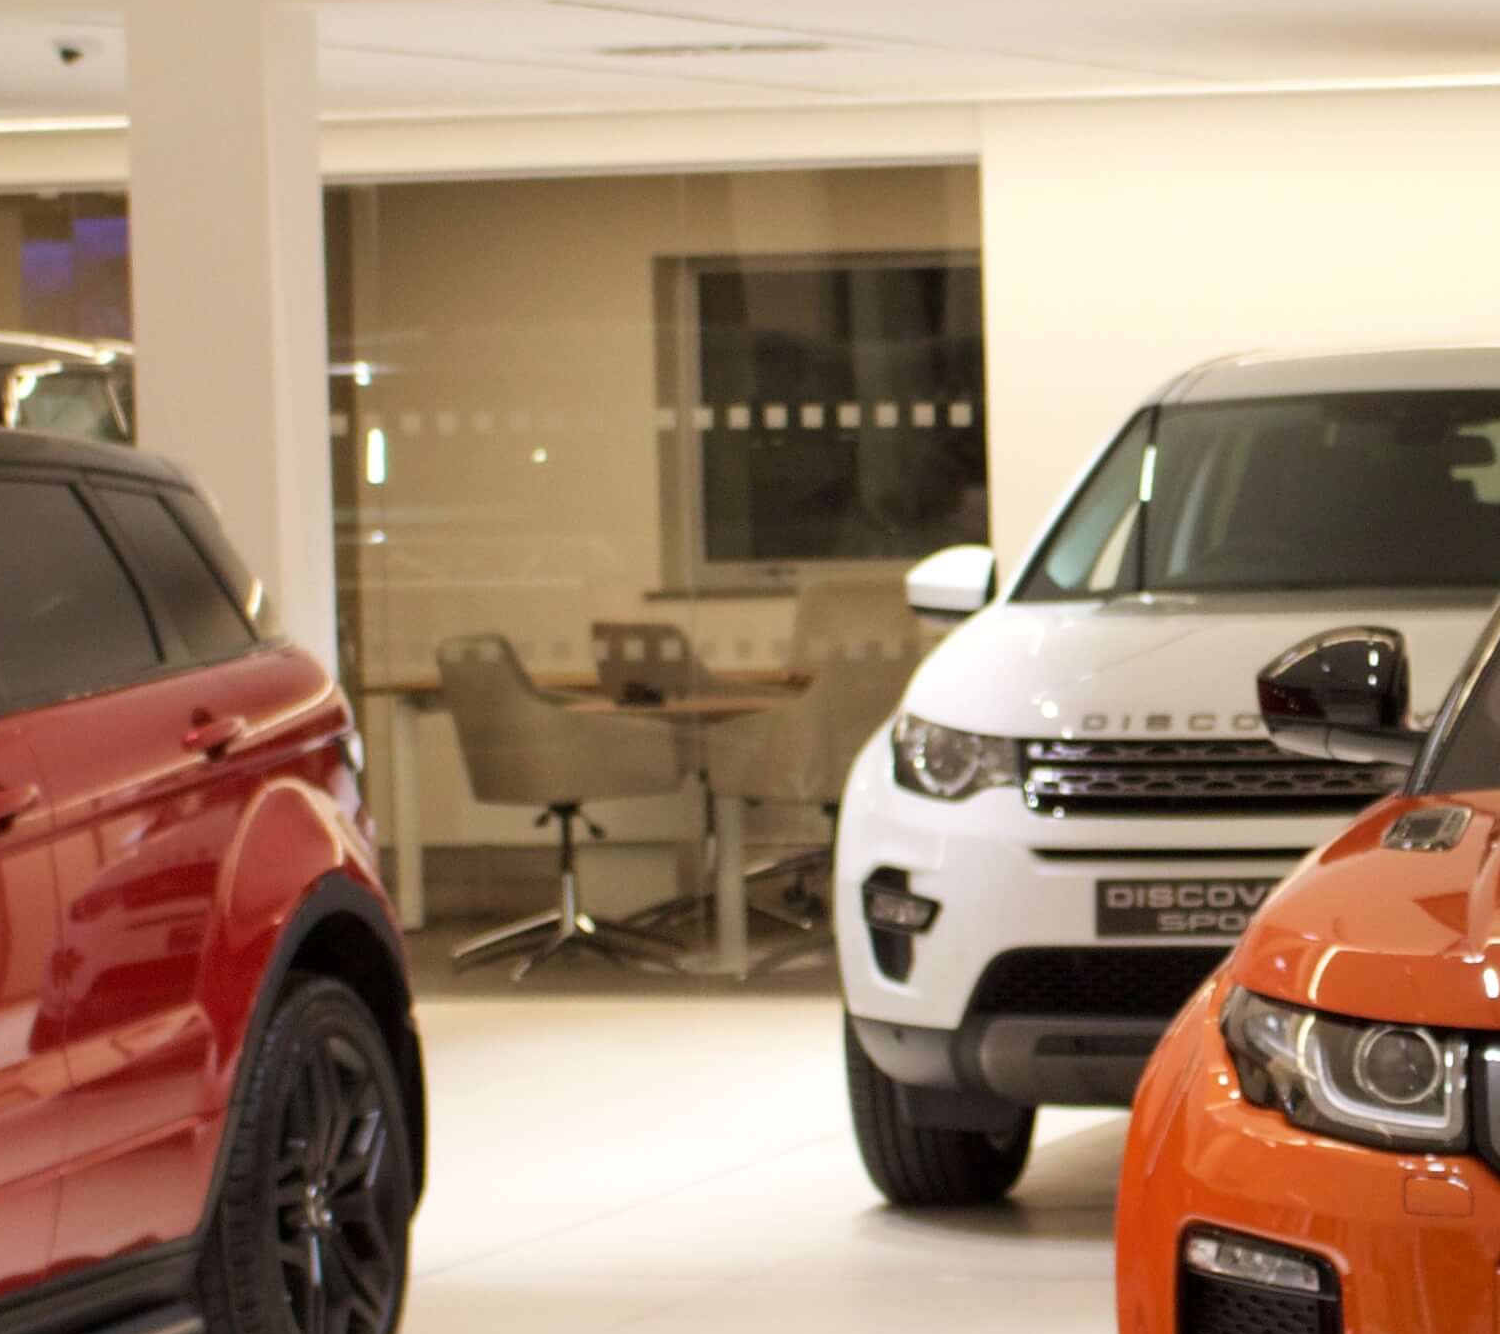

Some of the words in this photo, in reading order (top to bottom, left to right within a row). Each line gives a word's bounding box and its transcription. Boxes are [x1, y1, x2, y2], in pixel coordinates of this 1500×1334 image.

[1081, 713, 1261, 733] DISCO
[1106, 885, 1267, 908] DISCOV
[1156, 913, 1249, 931] SPO
